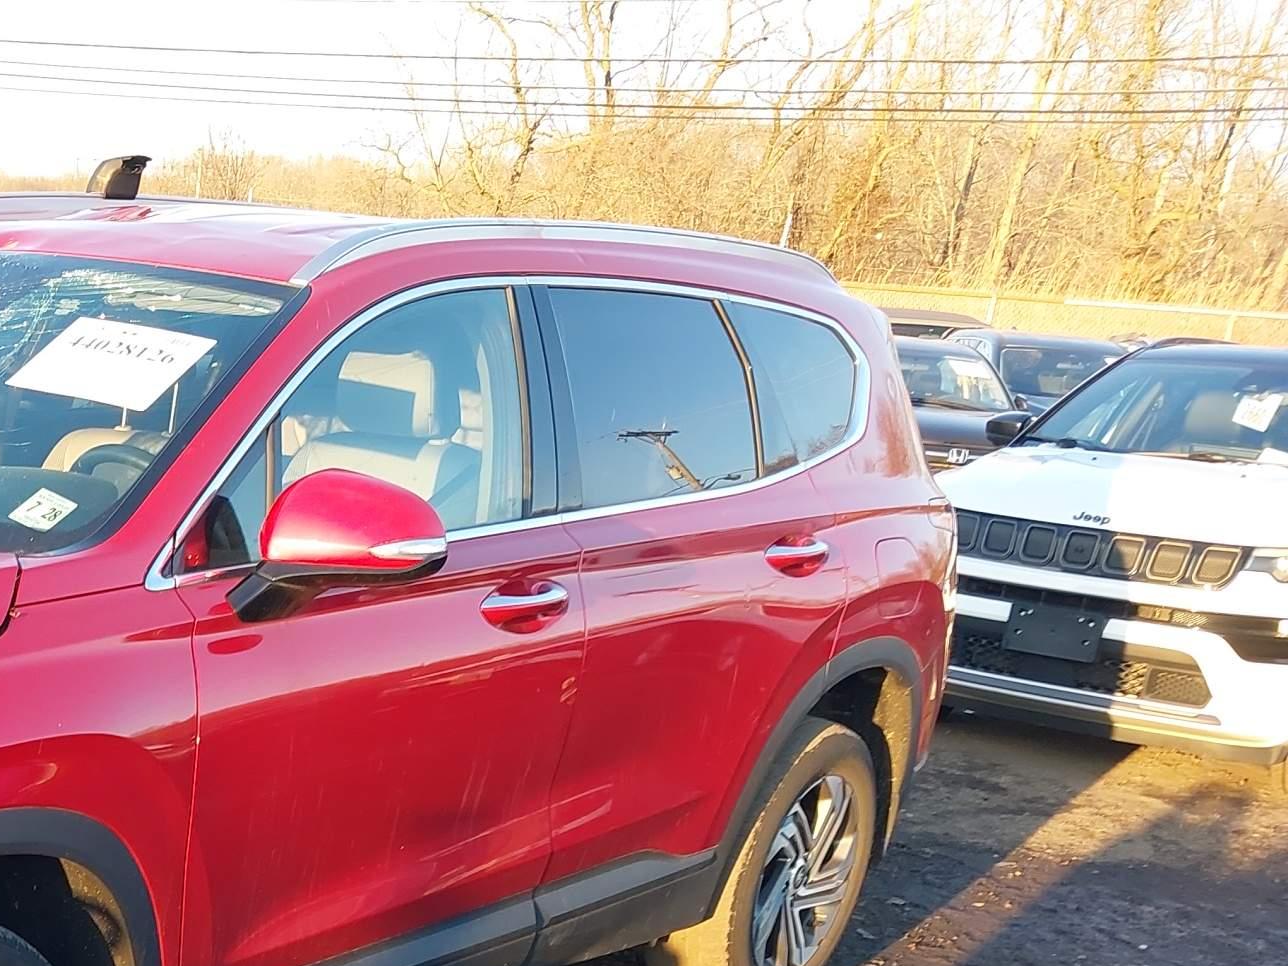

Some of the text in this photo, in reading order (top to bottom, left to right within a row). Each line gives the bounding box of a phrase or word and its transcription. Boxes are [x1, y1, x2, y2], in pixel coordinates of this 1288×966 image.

[25, 500, 43, 513] 7
[40, 507, 63, 522] 28
[1072, 511, 1112, 526] Jeep
